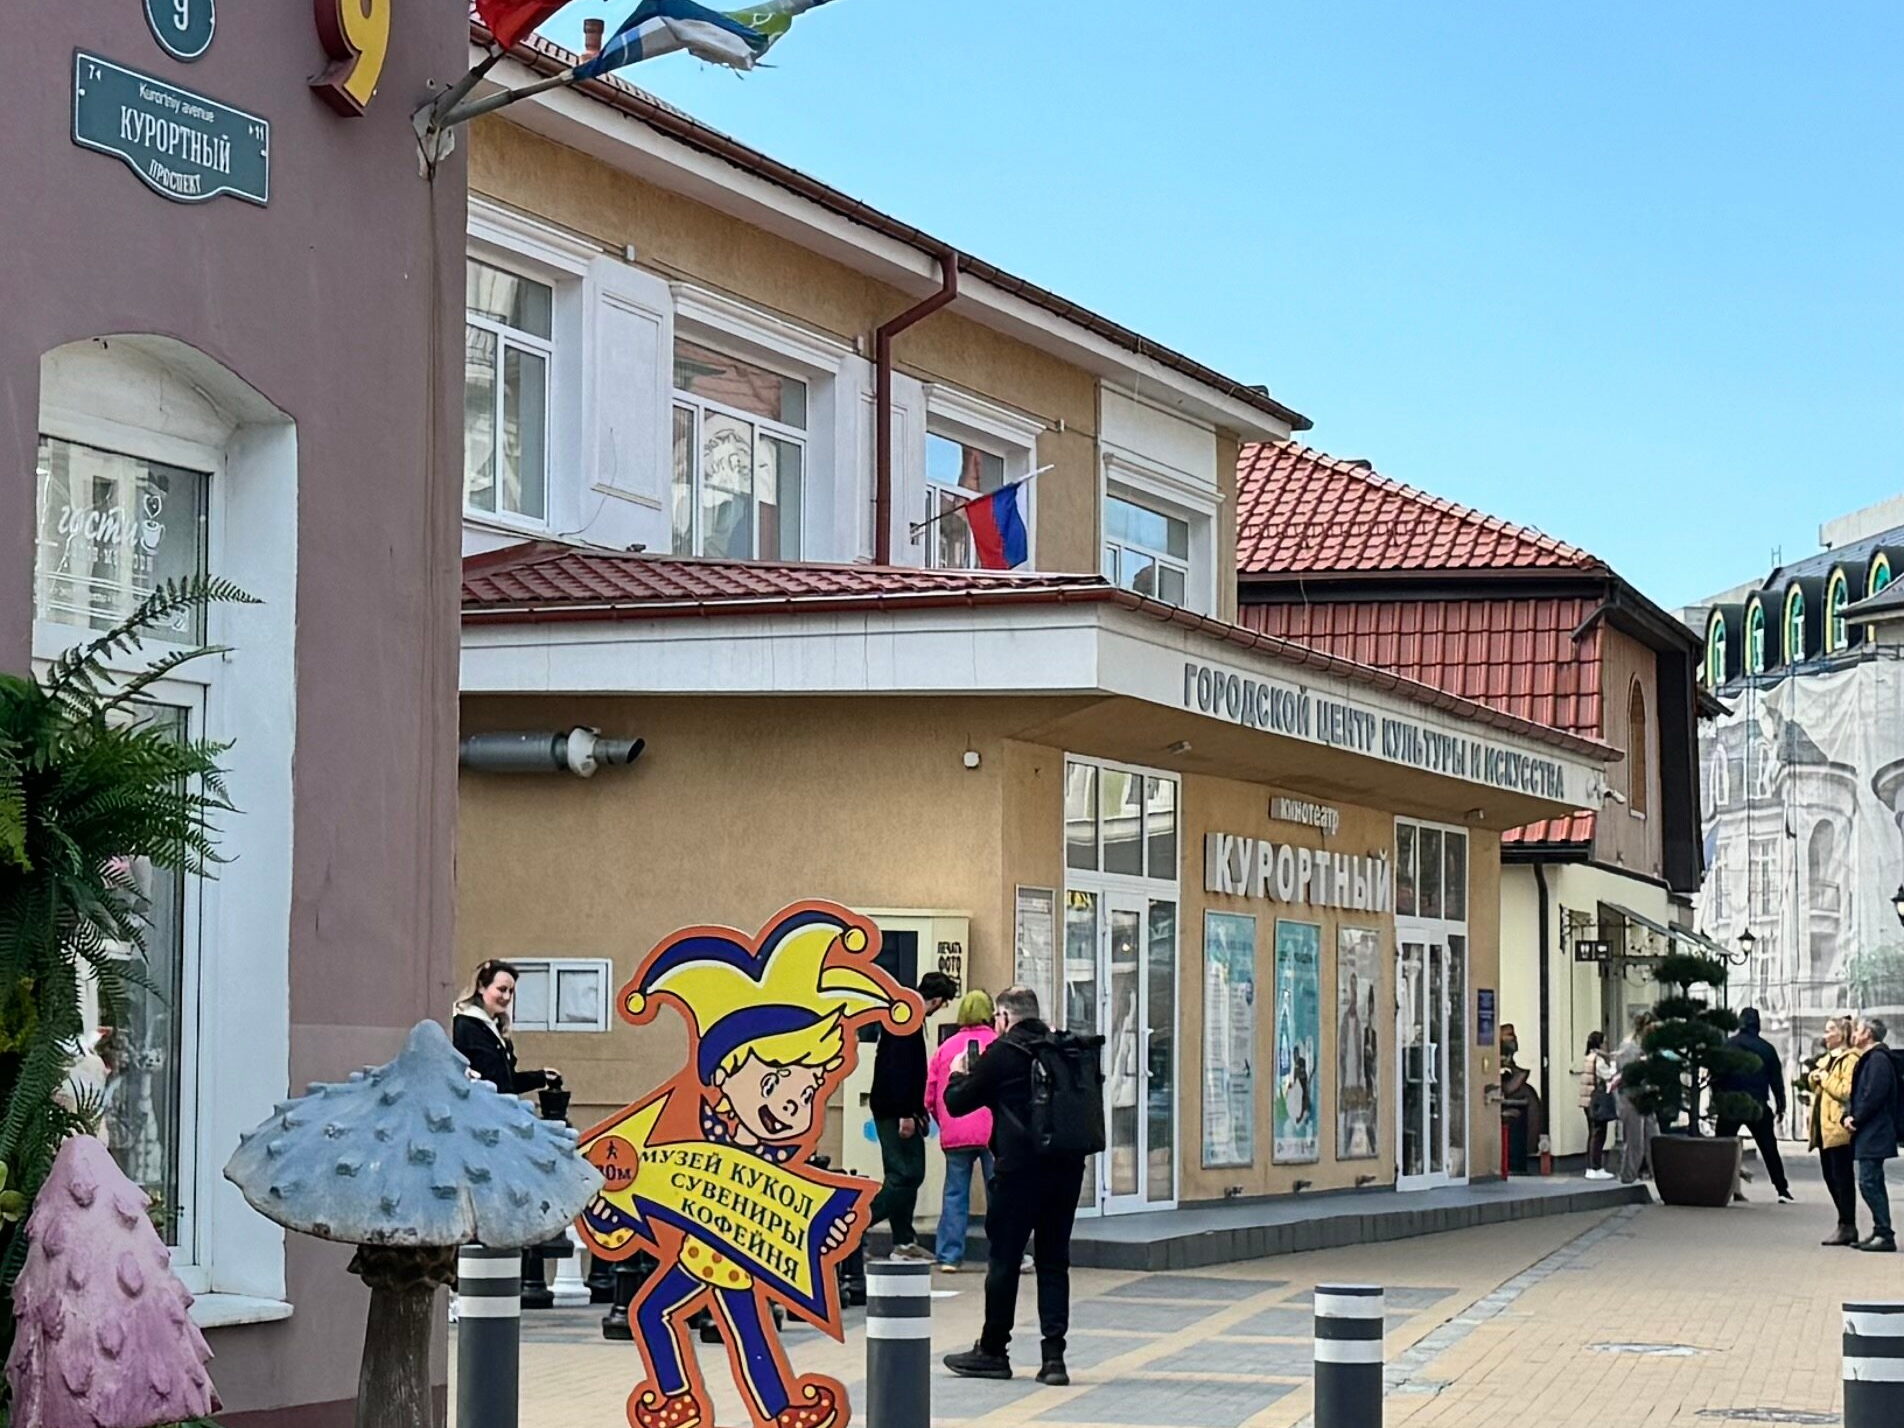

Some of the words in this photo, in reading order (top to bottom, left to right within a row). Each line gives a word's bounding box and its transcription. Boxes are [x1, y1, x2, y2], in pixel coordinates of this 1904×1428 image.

[120, 105, 231, 174] КУРОРТНЫЙ
[181, 102, 215, 123] avenue
[149, 159, 202, 194] ПРОСПЕКТ
[1183, 662, 1311, 737] ГОРОДСКОЙ
[1316, 699, 1376, 752] ЦЕНТР
[1381, 717, 1467, 776] КУЛЬТУРЫ
[1470, 741, 1481, 779] И
[1484, 746, 1565, 800] ИСКУССТВА
[1280, 797, 1340, 836] кинотеатр
[1214, 832, 1391, 913] КУРОРТНЫЙ
[638, 1149, 722, 1175] МУЗЕЙ
[729, 1161, 814, 1220] КУКОЛ
[670, 1172, 806, 1251] СУВЕНИРЫ
[681, 1197, 800, 1282] КОФЕЙНЯ
